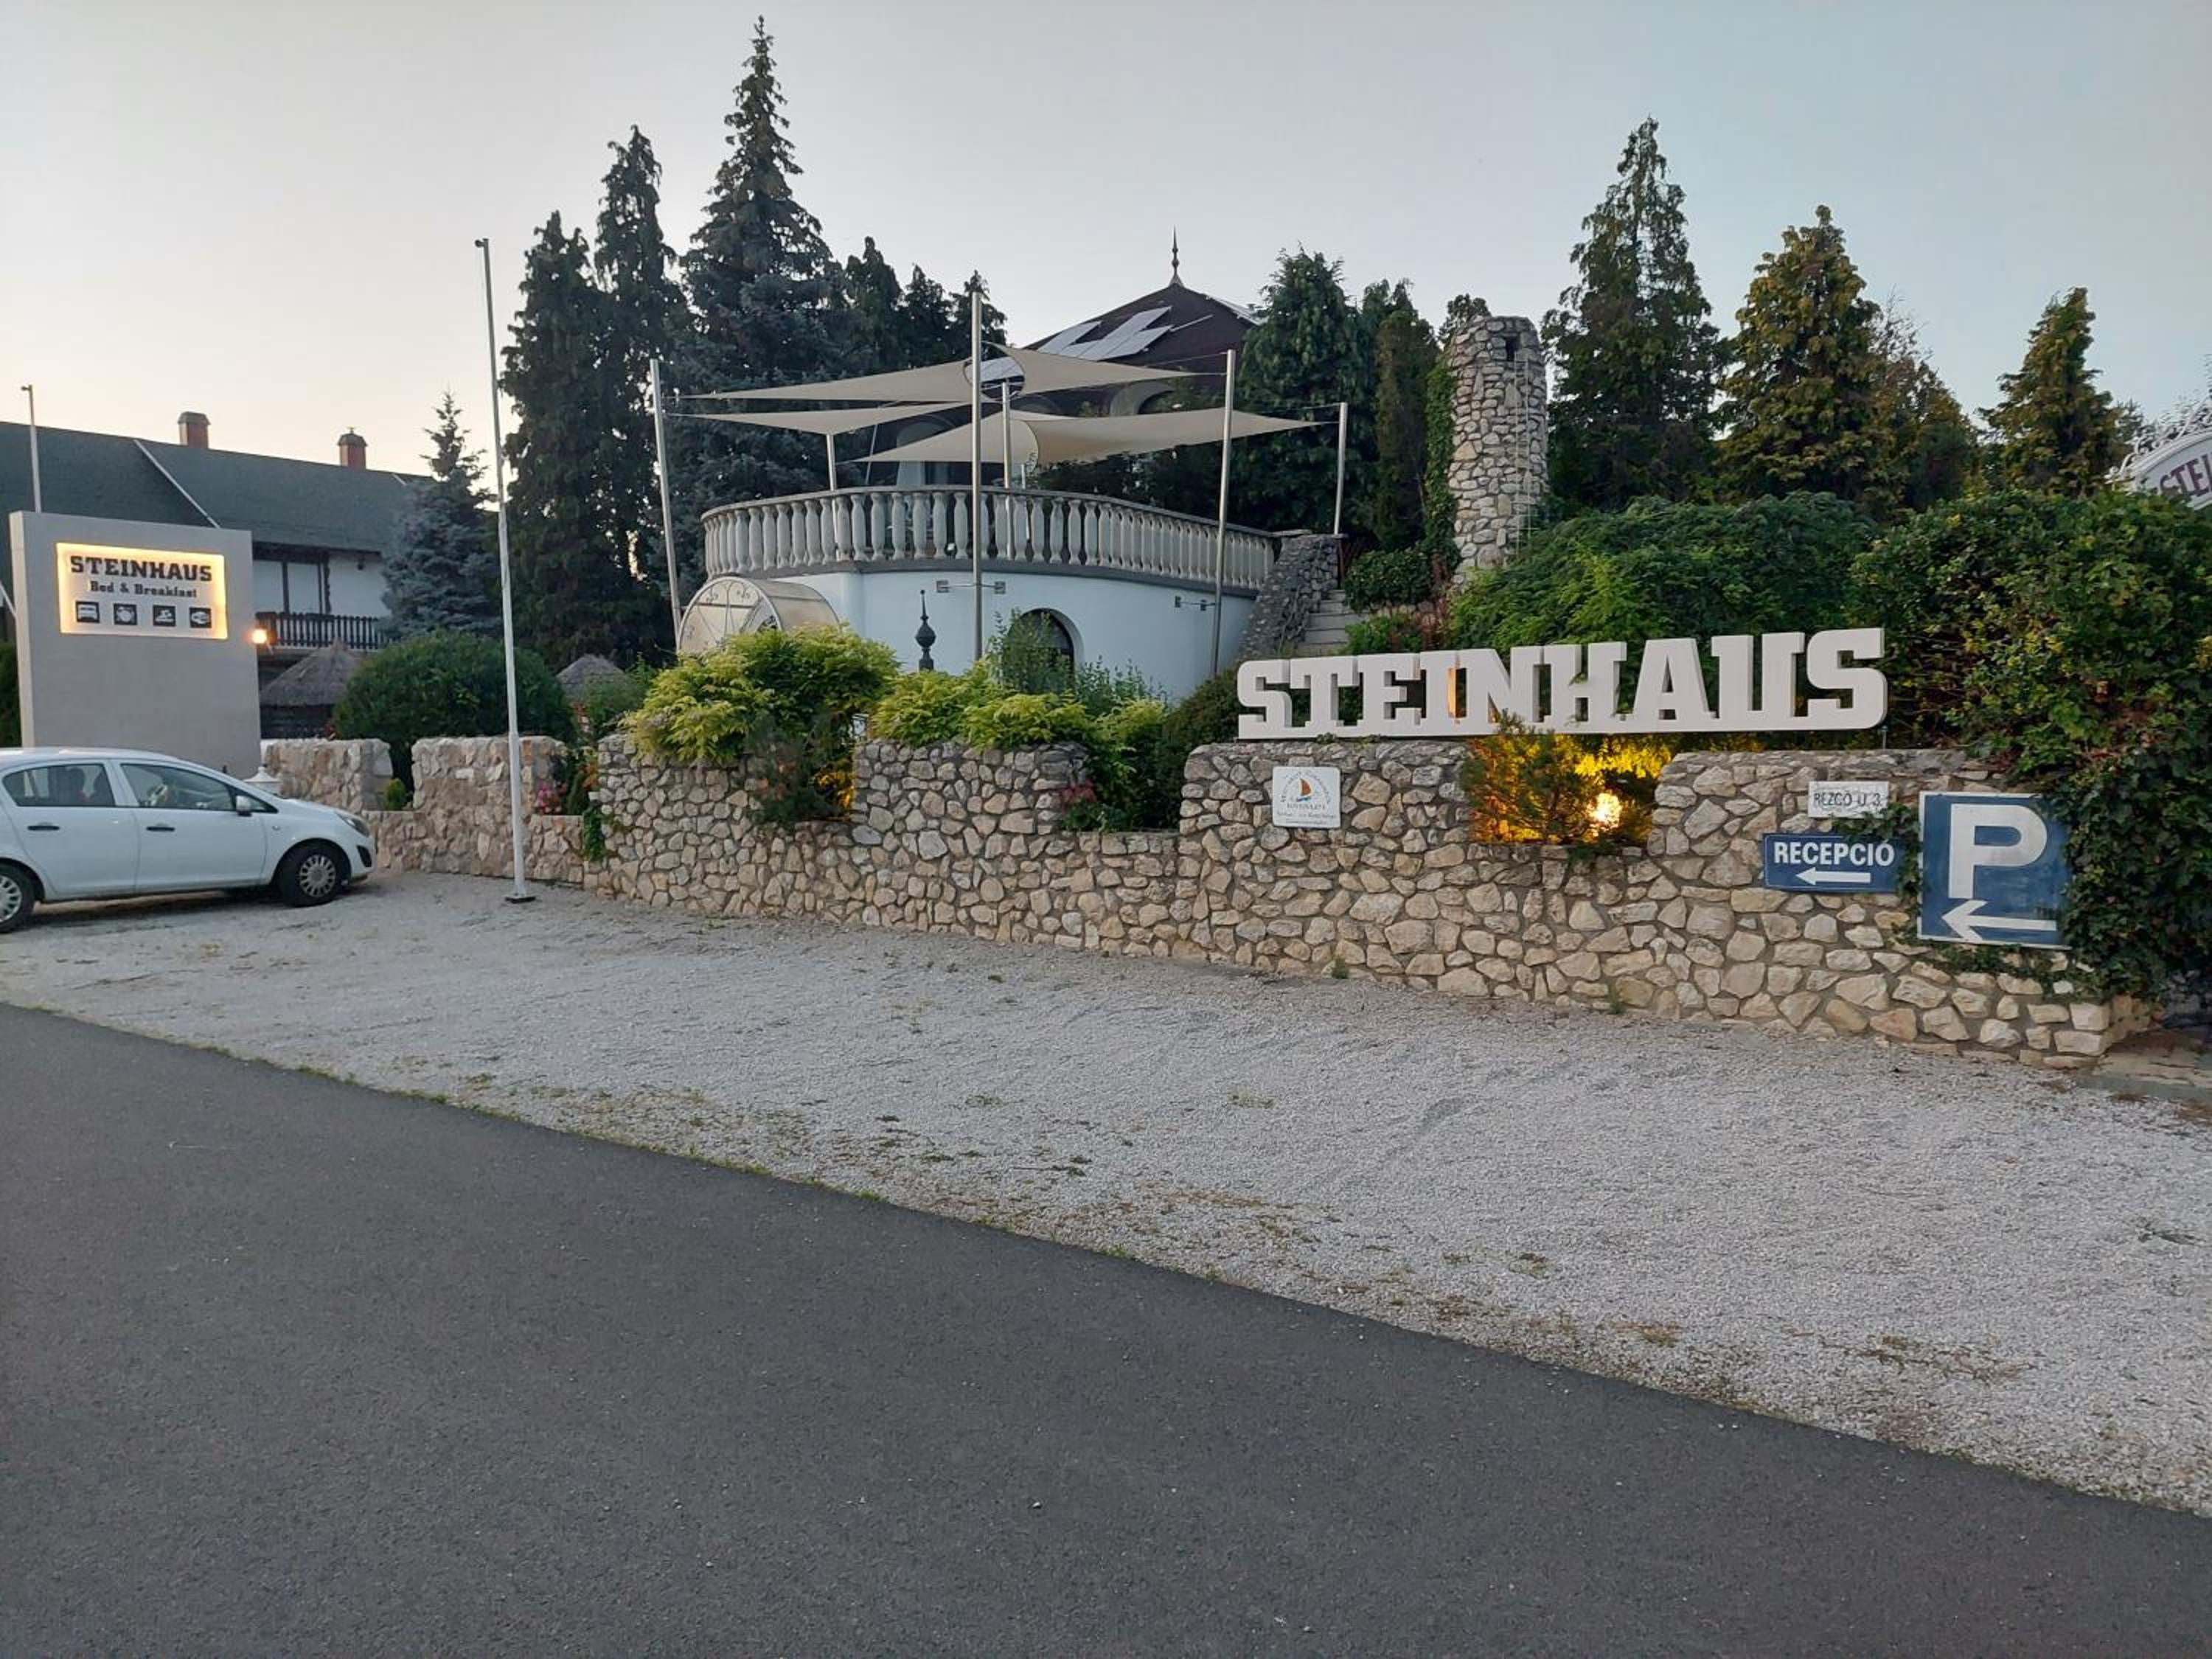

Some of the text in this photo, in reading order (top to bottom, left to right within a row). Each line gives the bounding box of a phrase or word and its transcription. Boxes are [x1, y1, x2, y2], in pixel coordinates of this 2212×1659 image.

[70, 555, 212, 582] STEINHAUS
[90, 581, 197, 598] Bed & Breakfast
[1237, 628, 1888, 740] STEINHAUS
[1949, 803, 2048, 899] P
